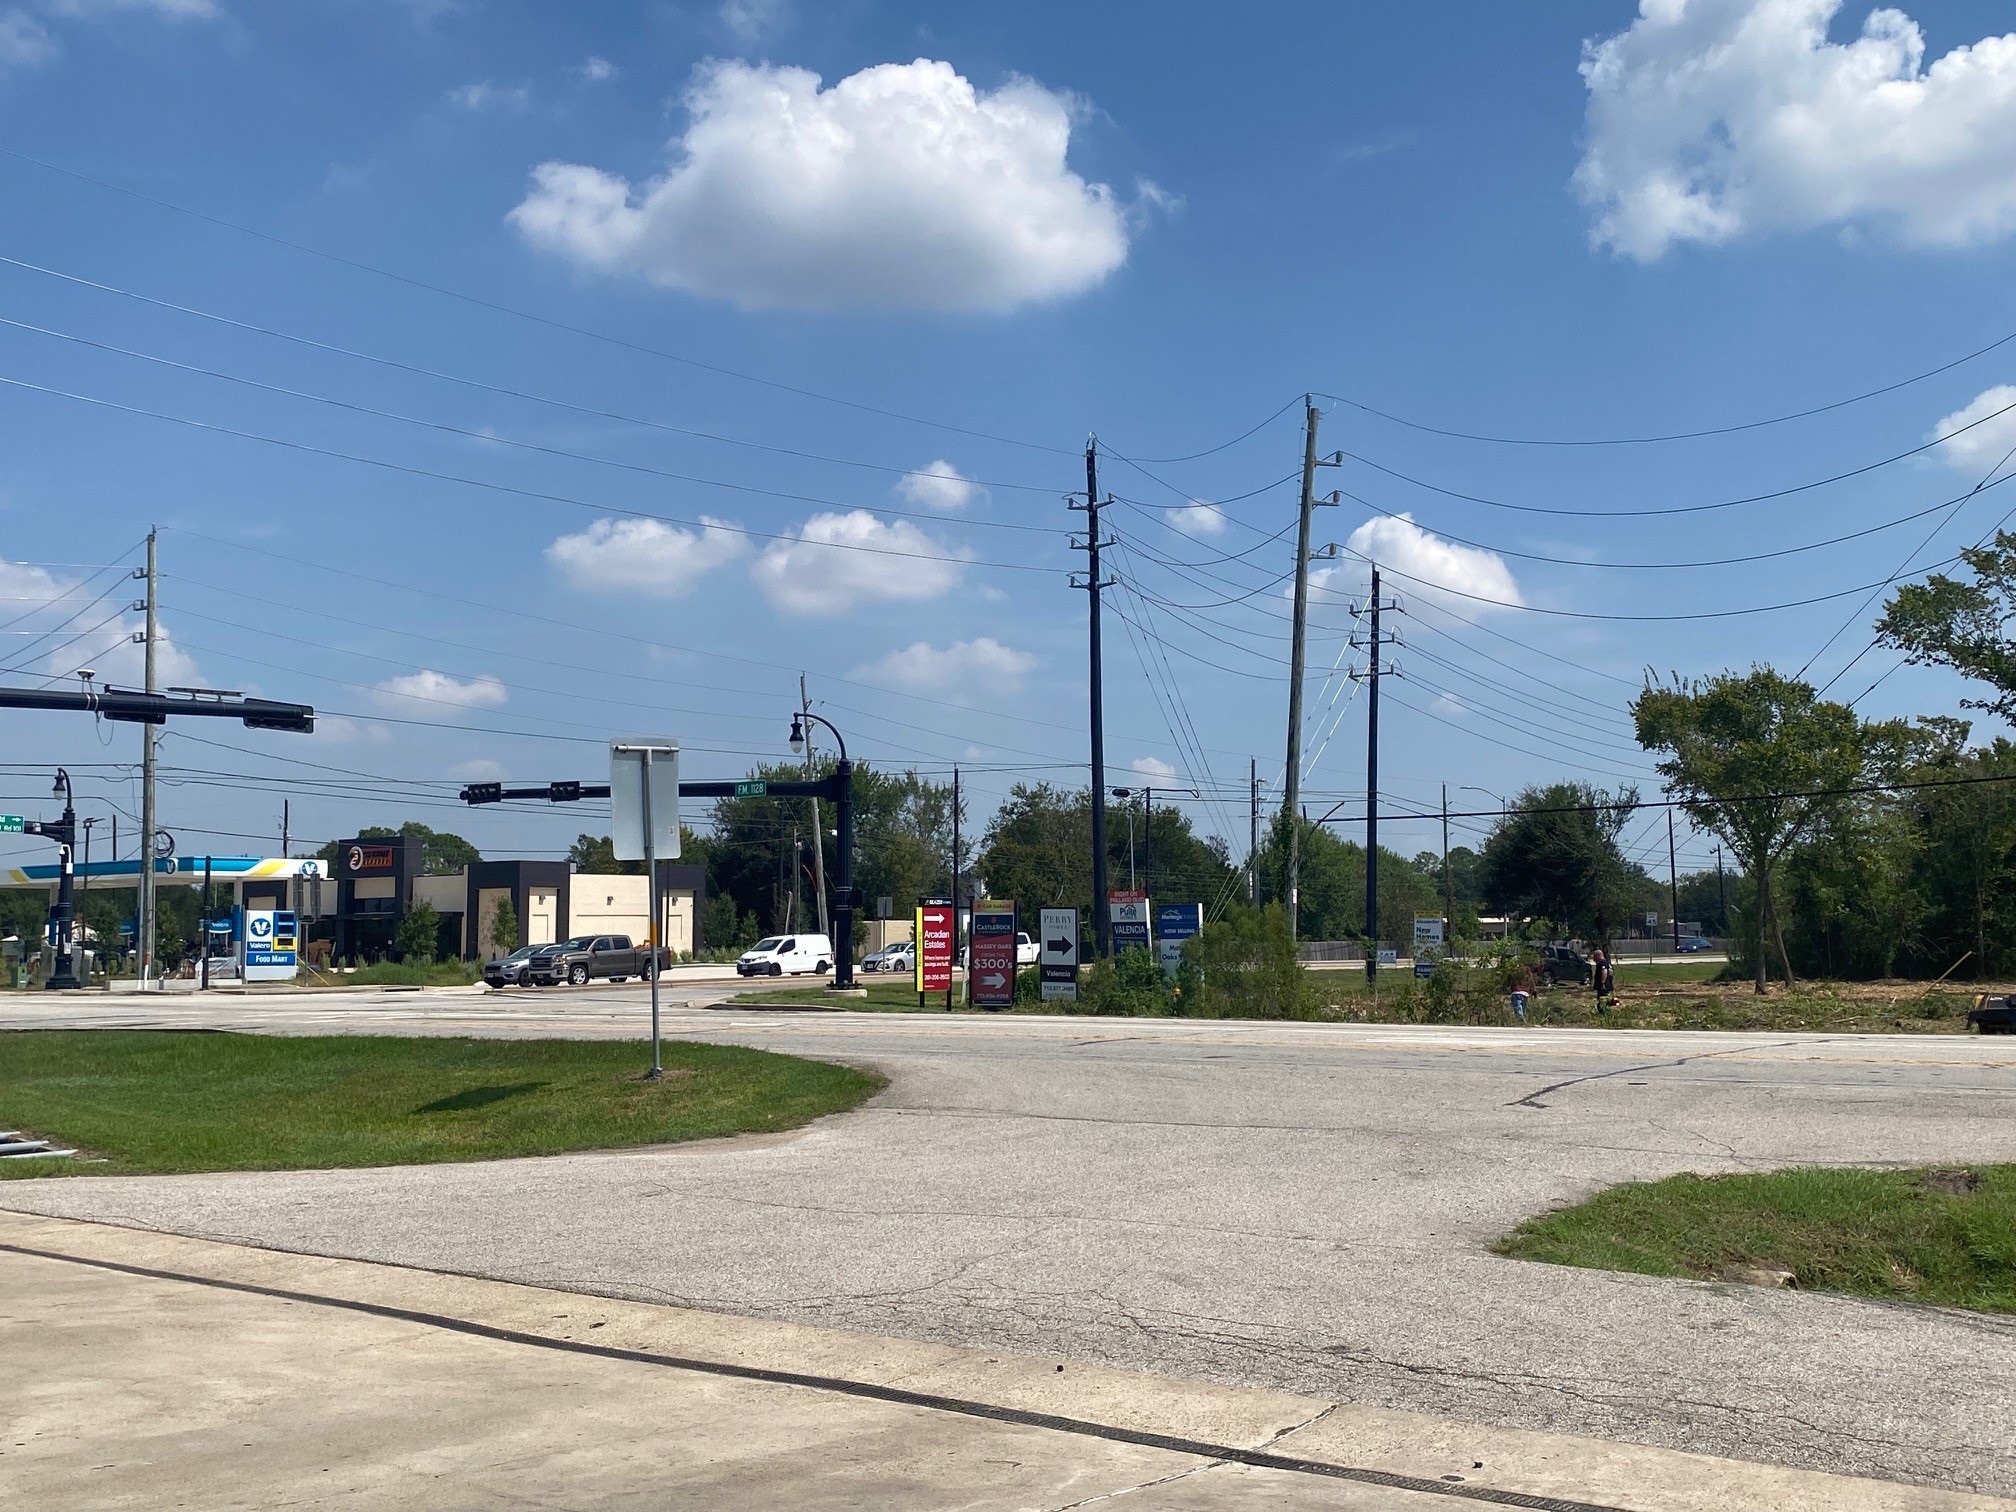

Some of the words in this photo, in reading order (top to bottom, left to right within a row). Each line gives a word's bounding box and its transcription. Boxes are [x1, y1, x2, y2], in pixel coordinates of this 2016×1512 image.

[1043, 914, 1072, 924] PERRY
[924, 929, 950, 939] Arcadian
[1114, 925, 1146, 934] VALENCIA
[924, 940, 946, 949] Estates
[974, 958, 1013, 970] $300's
[1046, 969, 1071, 978] Valencia
